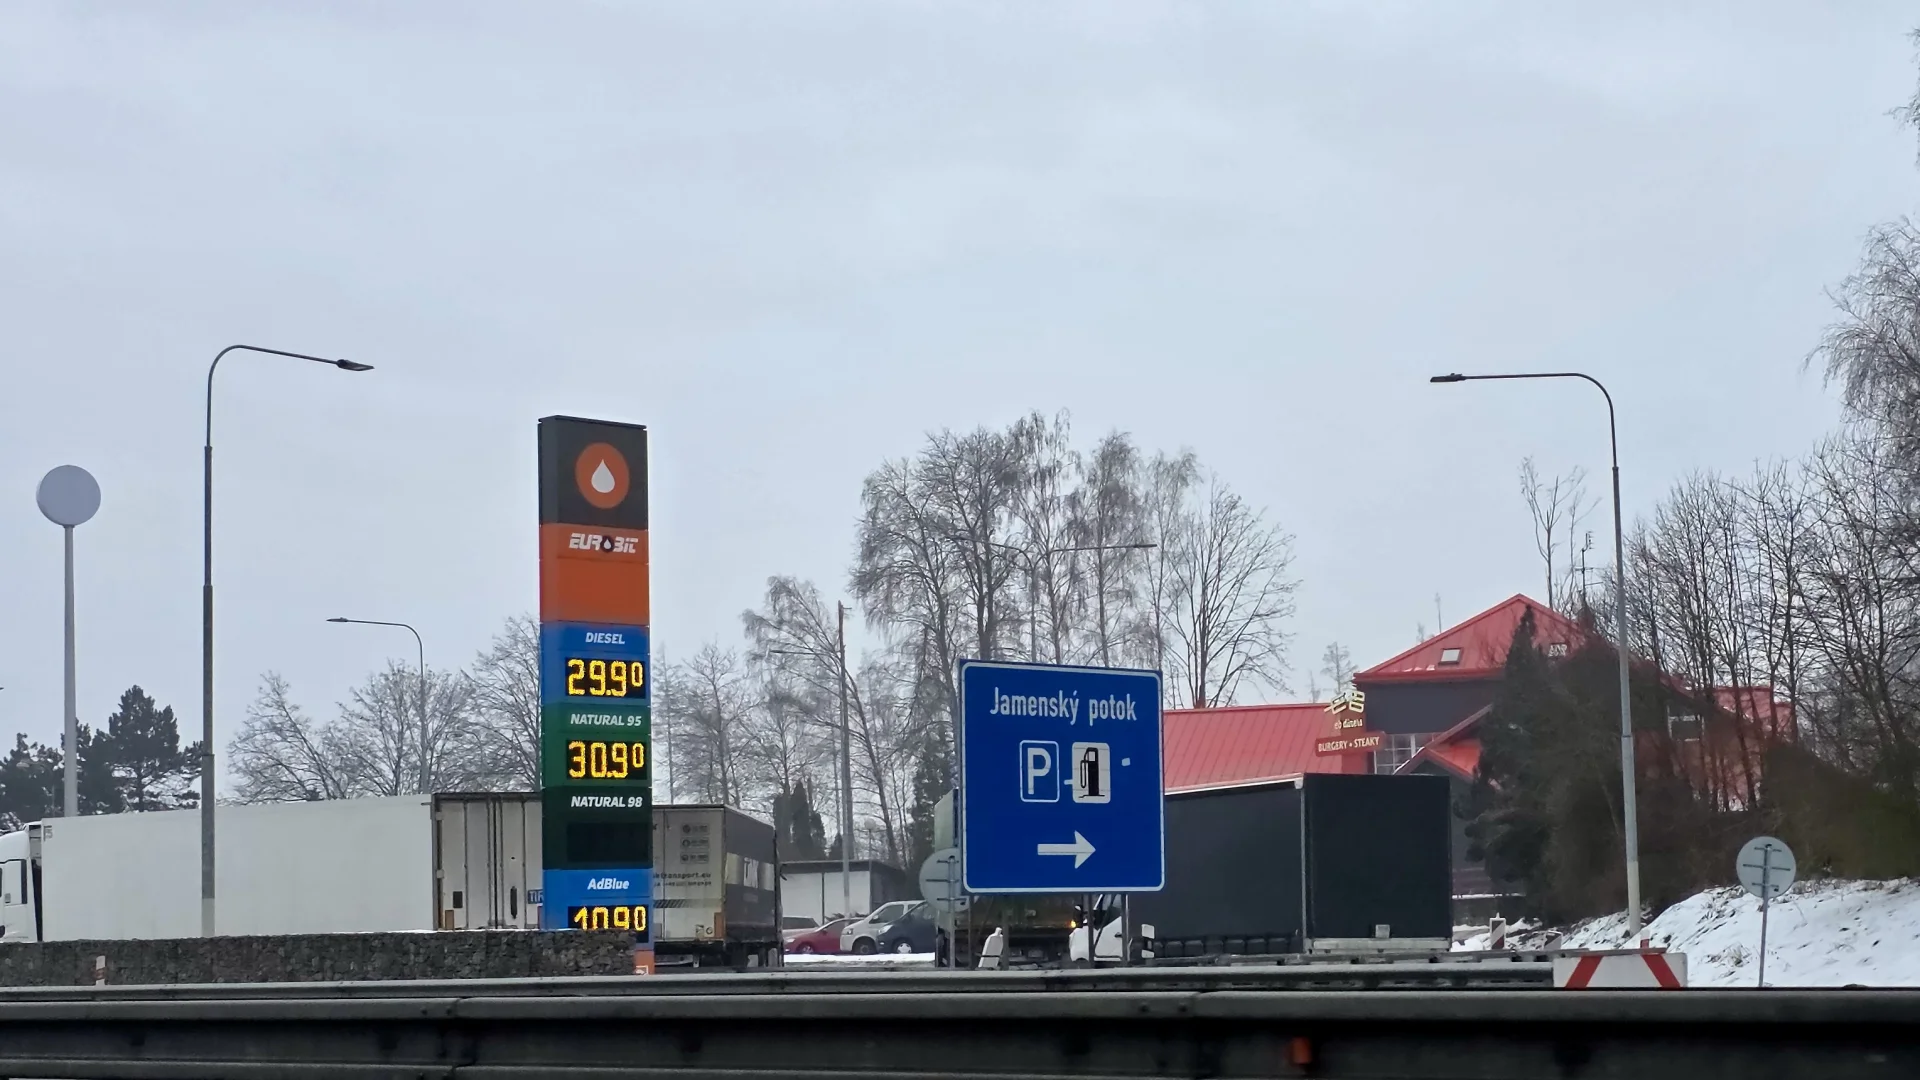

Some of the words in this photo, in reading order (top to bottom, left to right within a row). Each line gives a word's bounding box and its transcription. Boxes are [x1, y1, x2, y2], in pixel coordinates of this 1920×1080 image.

[585, 632, 626, 645] DIESEL
[989, 686, 1080, 726] Jamenský
[1088, 693, 1138, 727] potok
[570, 713, 625, 726] NATURAL
[626, 715, 642, 727] 95
[1317, 740, 1348, 753] BURGERY
[1353, 736, 1381, 749] STEAKY
[1027, 747, 1052, 796] P
[570, 795, 626, 808] NATURAL
[627, 796, 643, 808] 98
[587, 877, 630, 890] AdBlue
